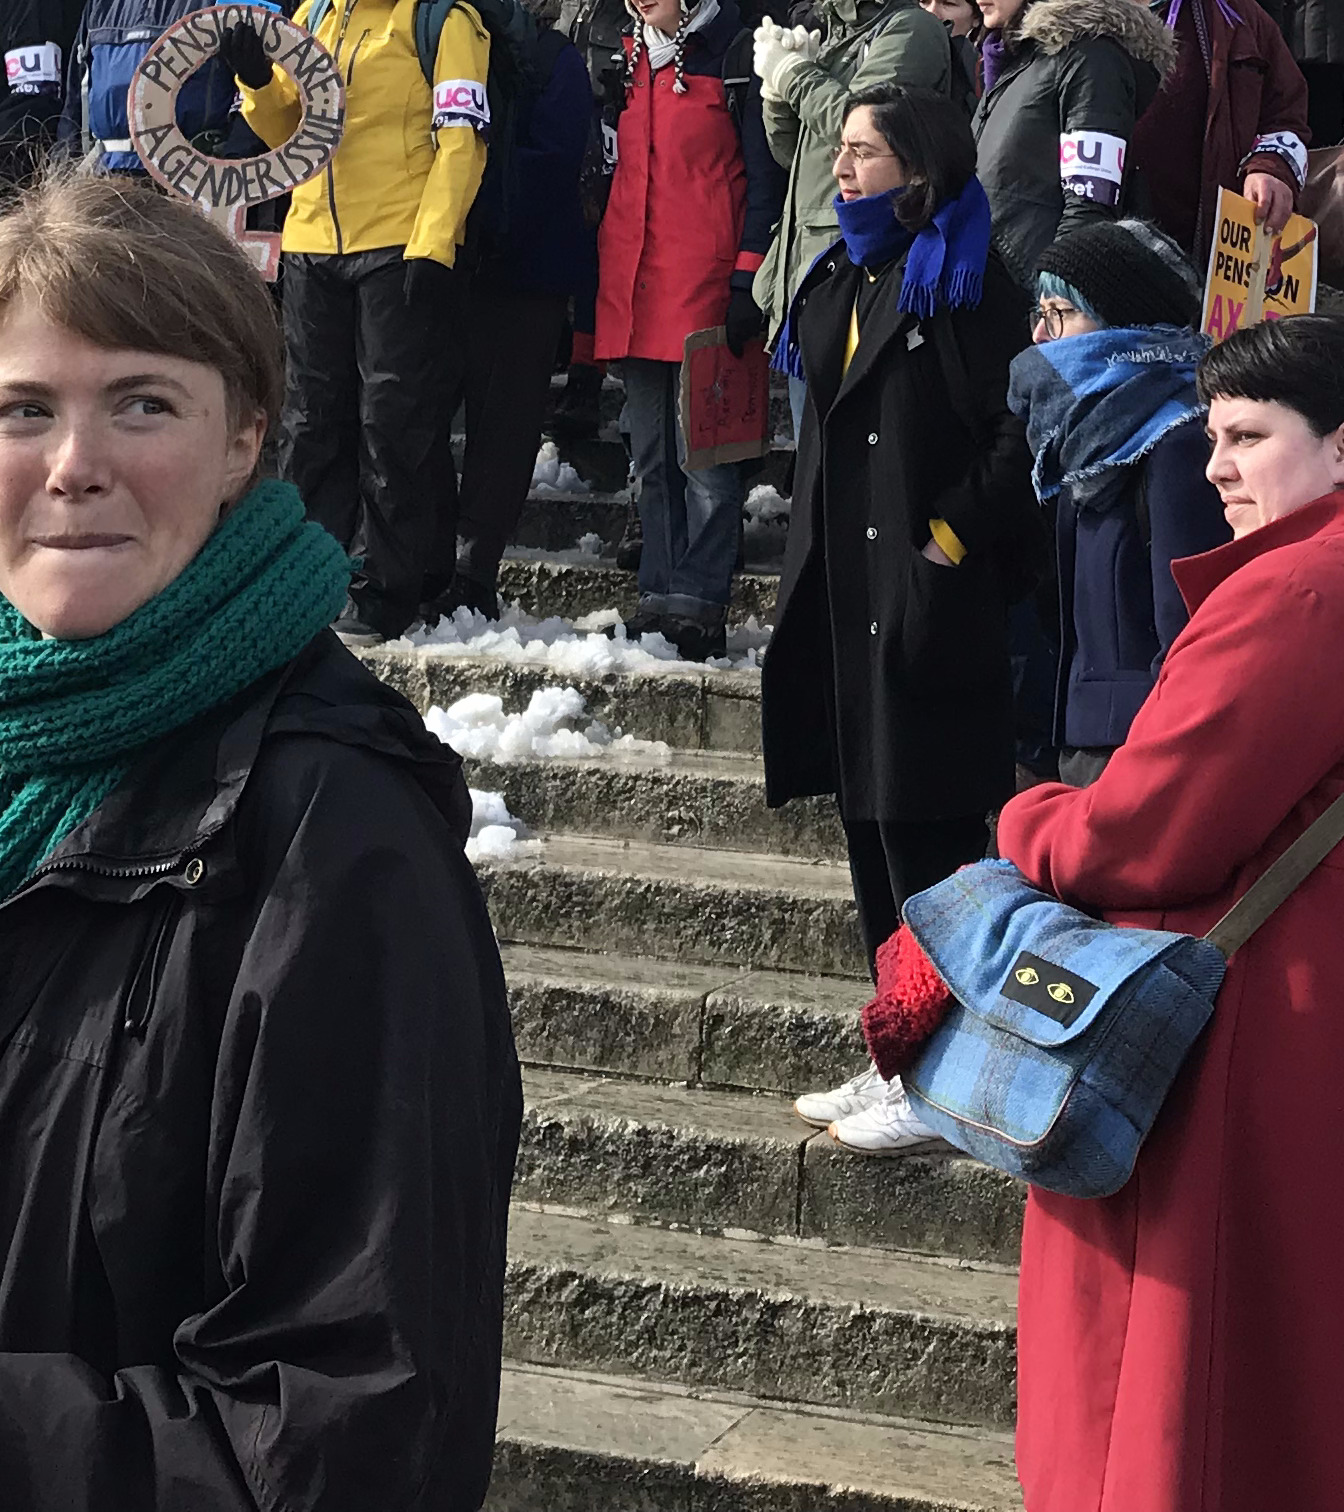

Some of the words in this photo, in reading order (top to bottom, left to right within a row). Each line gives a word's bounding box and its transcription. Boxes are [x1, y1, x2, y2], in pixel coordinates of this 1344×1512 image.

[6, 53, 42, 78] CU
[279, 36, 345, 102] ARE
[135, 123, 175, 160] A
[158, 144, 286, 208] GENDER
[1060, 139, 1103, 166] CU
[1220, 218, 1252, 254] OUR
